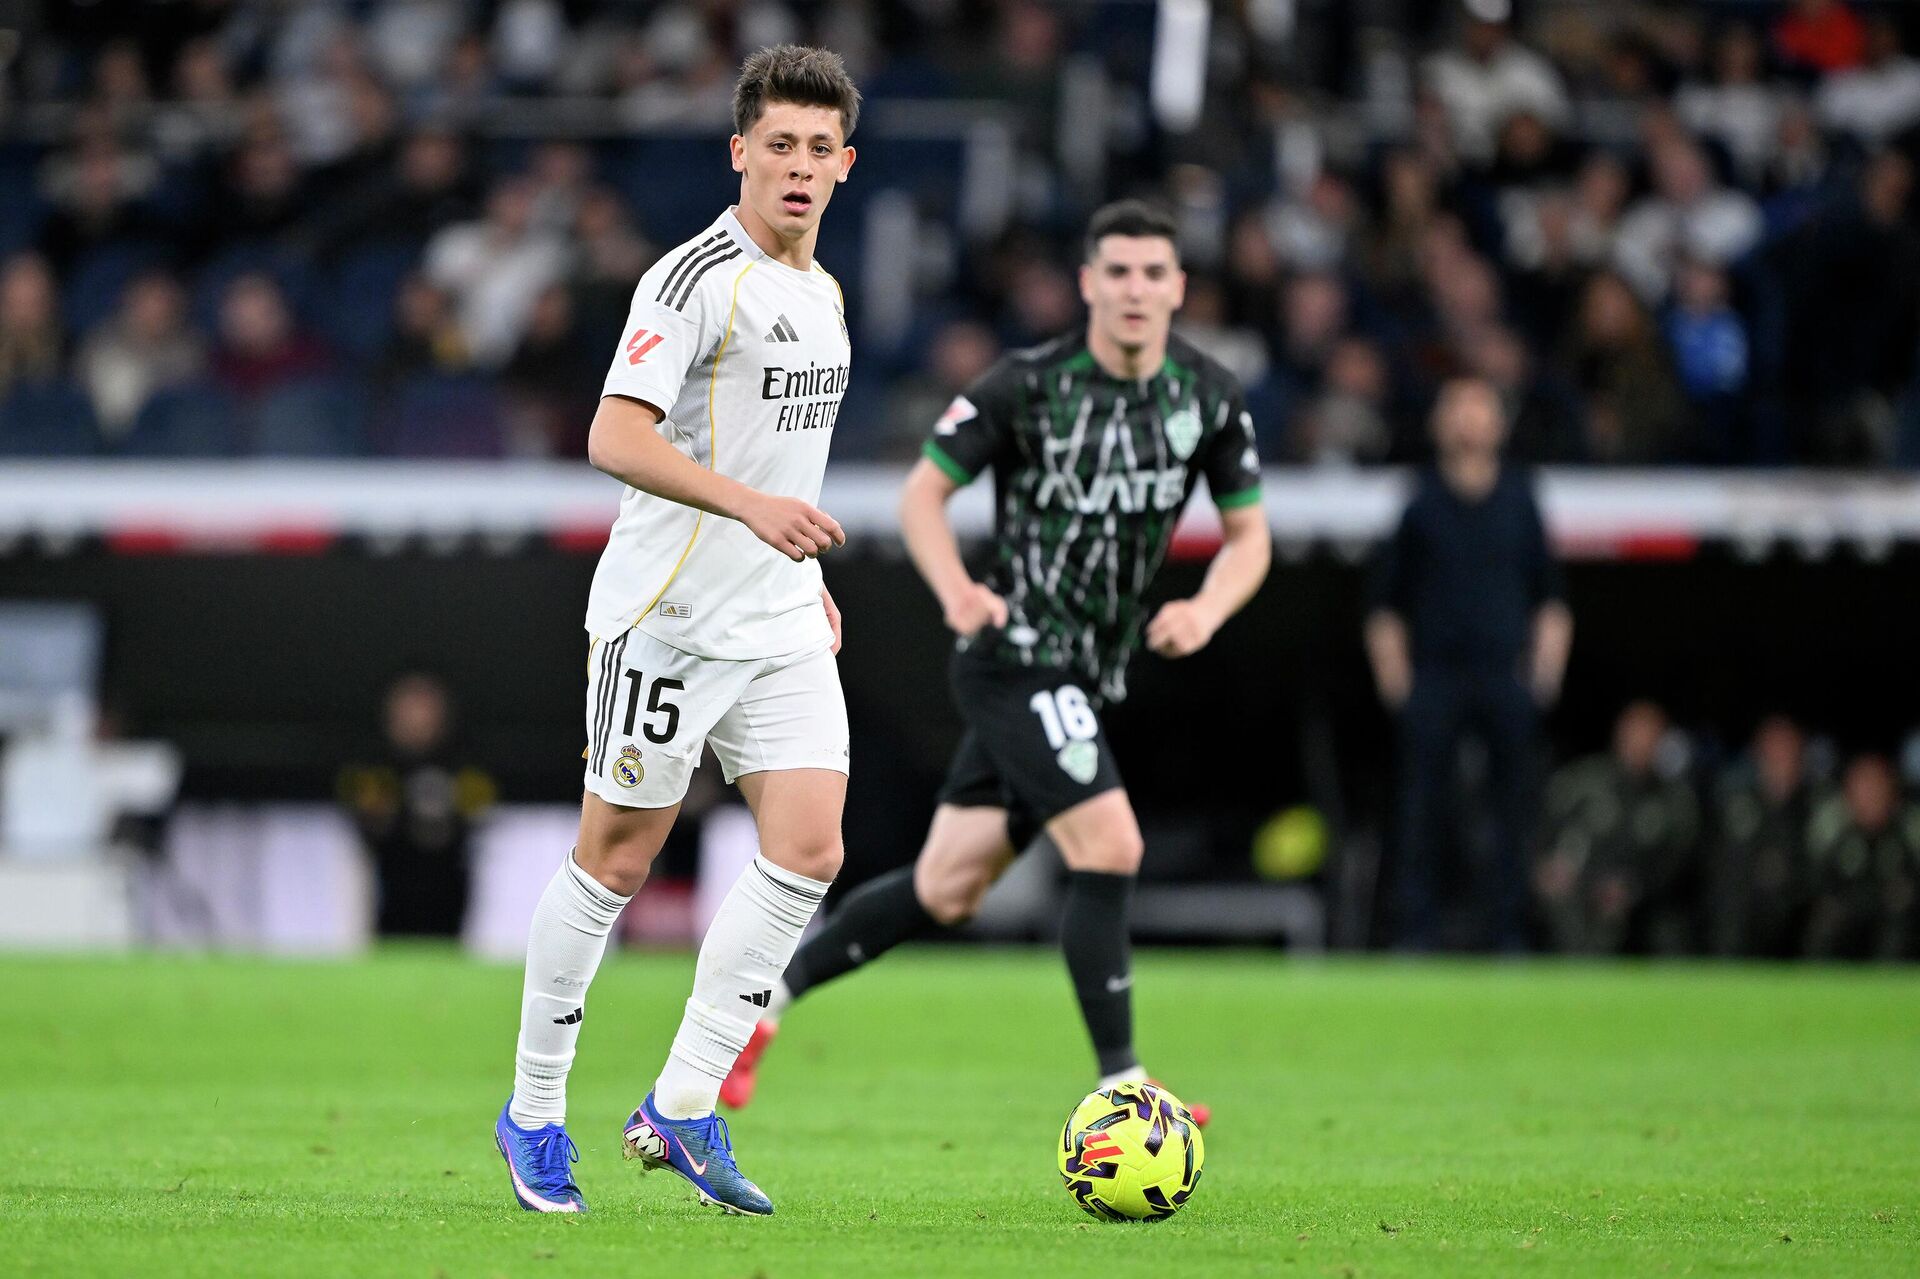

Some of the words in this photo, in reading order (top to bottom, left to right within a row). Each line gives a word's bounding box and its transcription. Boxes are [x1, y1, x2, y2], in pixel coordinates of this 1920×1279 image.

[761, 360, 848, 400] Emirate
[776, 404, 803, 432] FLY
[802, 400, 840, 429] BETTE
[622, 668, 685, 744] 15
[1029, 684, 1098, 749] 16
